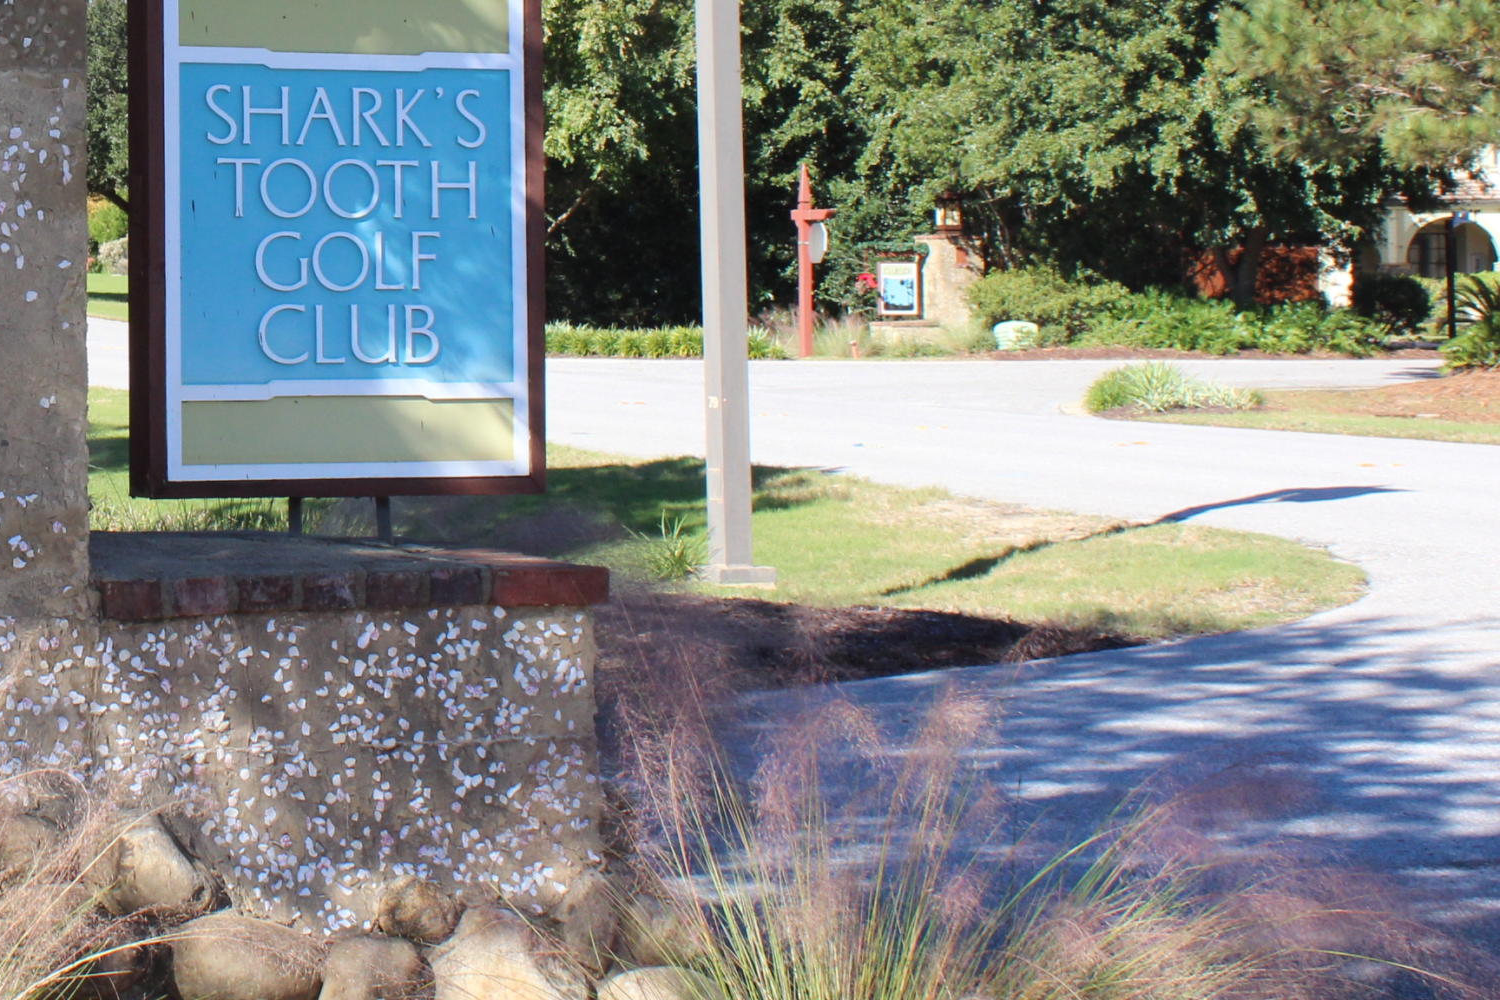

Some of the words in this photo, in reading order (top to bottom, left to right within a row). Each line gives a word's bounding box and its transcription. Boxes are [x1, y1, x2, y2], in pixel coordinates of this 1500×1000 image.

[204, 83, 487, 149] SHARK'S
[216, 157, 477, 219] TOOTH
[255, 230, 441, 292] GOLF
[258, 303, 440, 365] CLUB
